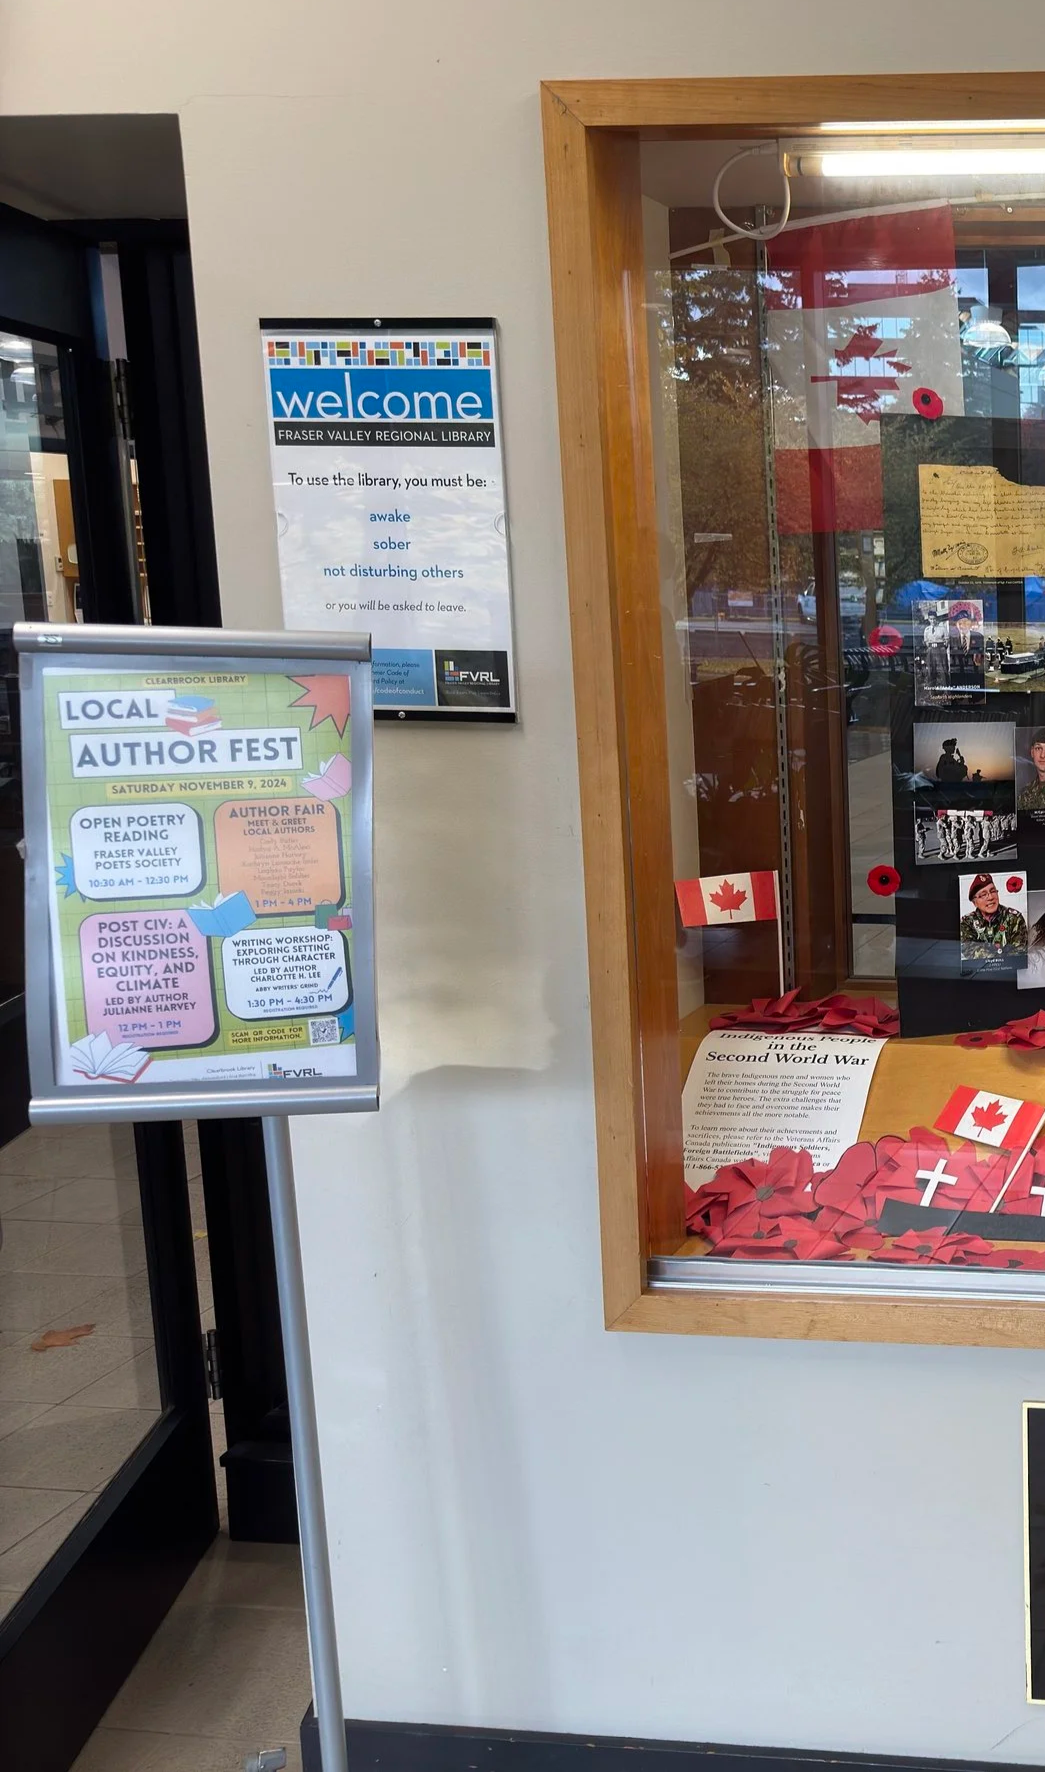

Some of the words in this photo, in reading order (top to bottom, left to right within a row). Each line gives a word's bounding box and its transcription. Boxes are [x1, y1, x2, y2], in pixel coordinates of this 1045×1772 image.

[276, 372, 483, 420] welcome
[278, 430, 324, 441] FRASER
[327, 430, 371, 442] VALLEY
[375, 431, 438, 442] REGIONAL
[441, 431, 491, 442] LIBRARY
[288, 473, 303, 487] To
[307, 476, 329, 487] use
[333, 474, 354, 487] the
[358, 474, 401, 489] library,
[405, 477, 428, 491] you
[431, 475, 462, 487] must
[467, 475, 487, 488] be:
[370, 509, 411, 523] awake
[373, 537, 411, 551] sober
[324, 566, 345, 577] not
[349, 564, 417, 580] disturbing
[421, 565, 464, 579] others
[326, 603, 336, 612] or
[339, 603, 356, 614] you
[359, 600, 376, 611] will
[378, 600, 391, 611] be
[393, 600, 422, 612] asked
[425, 603, 435, 612] to
[437, 601, 466, 614] leave.
[145, 677, 206, 685] CLEARBROOK
[209, 675, 246, 684] LIBRARY
[459, 671, 500, 682] FVRL
[66, 698, 158, 721] LOCAL
[77, 739, 217, 768] AUTHOR
[231, 737, 297, 762] FEST
[112, 783, 175, 794] SATURDAY
[180, 780, 244, 791] NOVEMBER
[248, 780, 257, 789] 9,
[260, 779, 287, 788] 2024
[229, 806, 289, 818] AUTHOR
[295, 804, 325, 815] FAIR
[80, 817, 122, 829] OPEN
[128, 814, 185, 827] POETRY
[104, 829, 168, 842] READING
[274, 826, 315, 834] AUTHORS
[94, 849, 134, 859] FRASER
[137, 847, 178, 856] VALLEY
[96, 860, 131, 870] POETS
[135, 858, 182, 868] SOCIETY
[89, 879, 115, 888] 10:30
[118, 878, 134, 886] AM
[146, 876, 170, 884] 12:30
[174, 875, 188, 883] PM
[99, 920, 138, 933] POST
[144, 919, 173, 930] CIV:
[177, 918, 187, 928] A
[99, 933, 190, 948] DISCUSSION
[232, 937, 272, 947] WRITING
[275, 934, 333, 944] WORKSHOP:
[92, 952, 115, 963] ON
[122, 947, 199, 962] KINDNESS,
[237, 946, 290, 957] EXPLORING
[293, 944, 330, 953] SETTING
[232, 955, 279, 965] THROUGH
[282, 953, 336, 963] CHARACTER
[97, 964, 158, 978] EQUITY,
[163, 962, 195, 974] AND
[116, 977, 179, 991] CLIMATE
[103, 1005, 152, 1016] JULIANNE
[156, 1002, 196, 1012] HARVEY
[720, 1033, 815, 1041] Indigenous
[820, 1036, 876, 1044] People
[790, 1043, 817, 1051] the
[706, 1051, 769, 1062] Second
[775, 1054, 829, 1064] World
[834, 1055, 869, 1066] War
